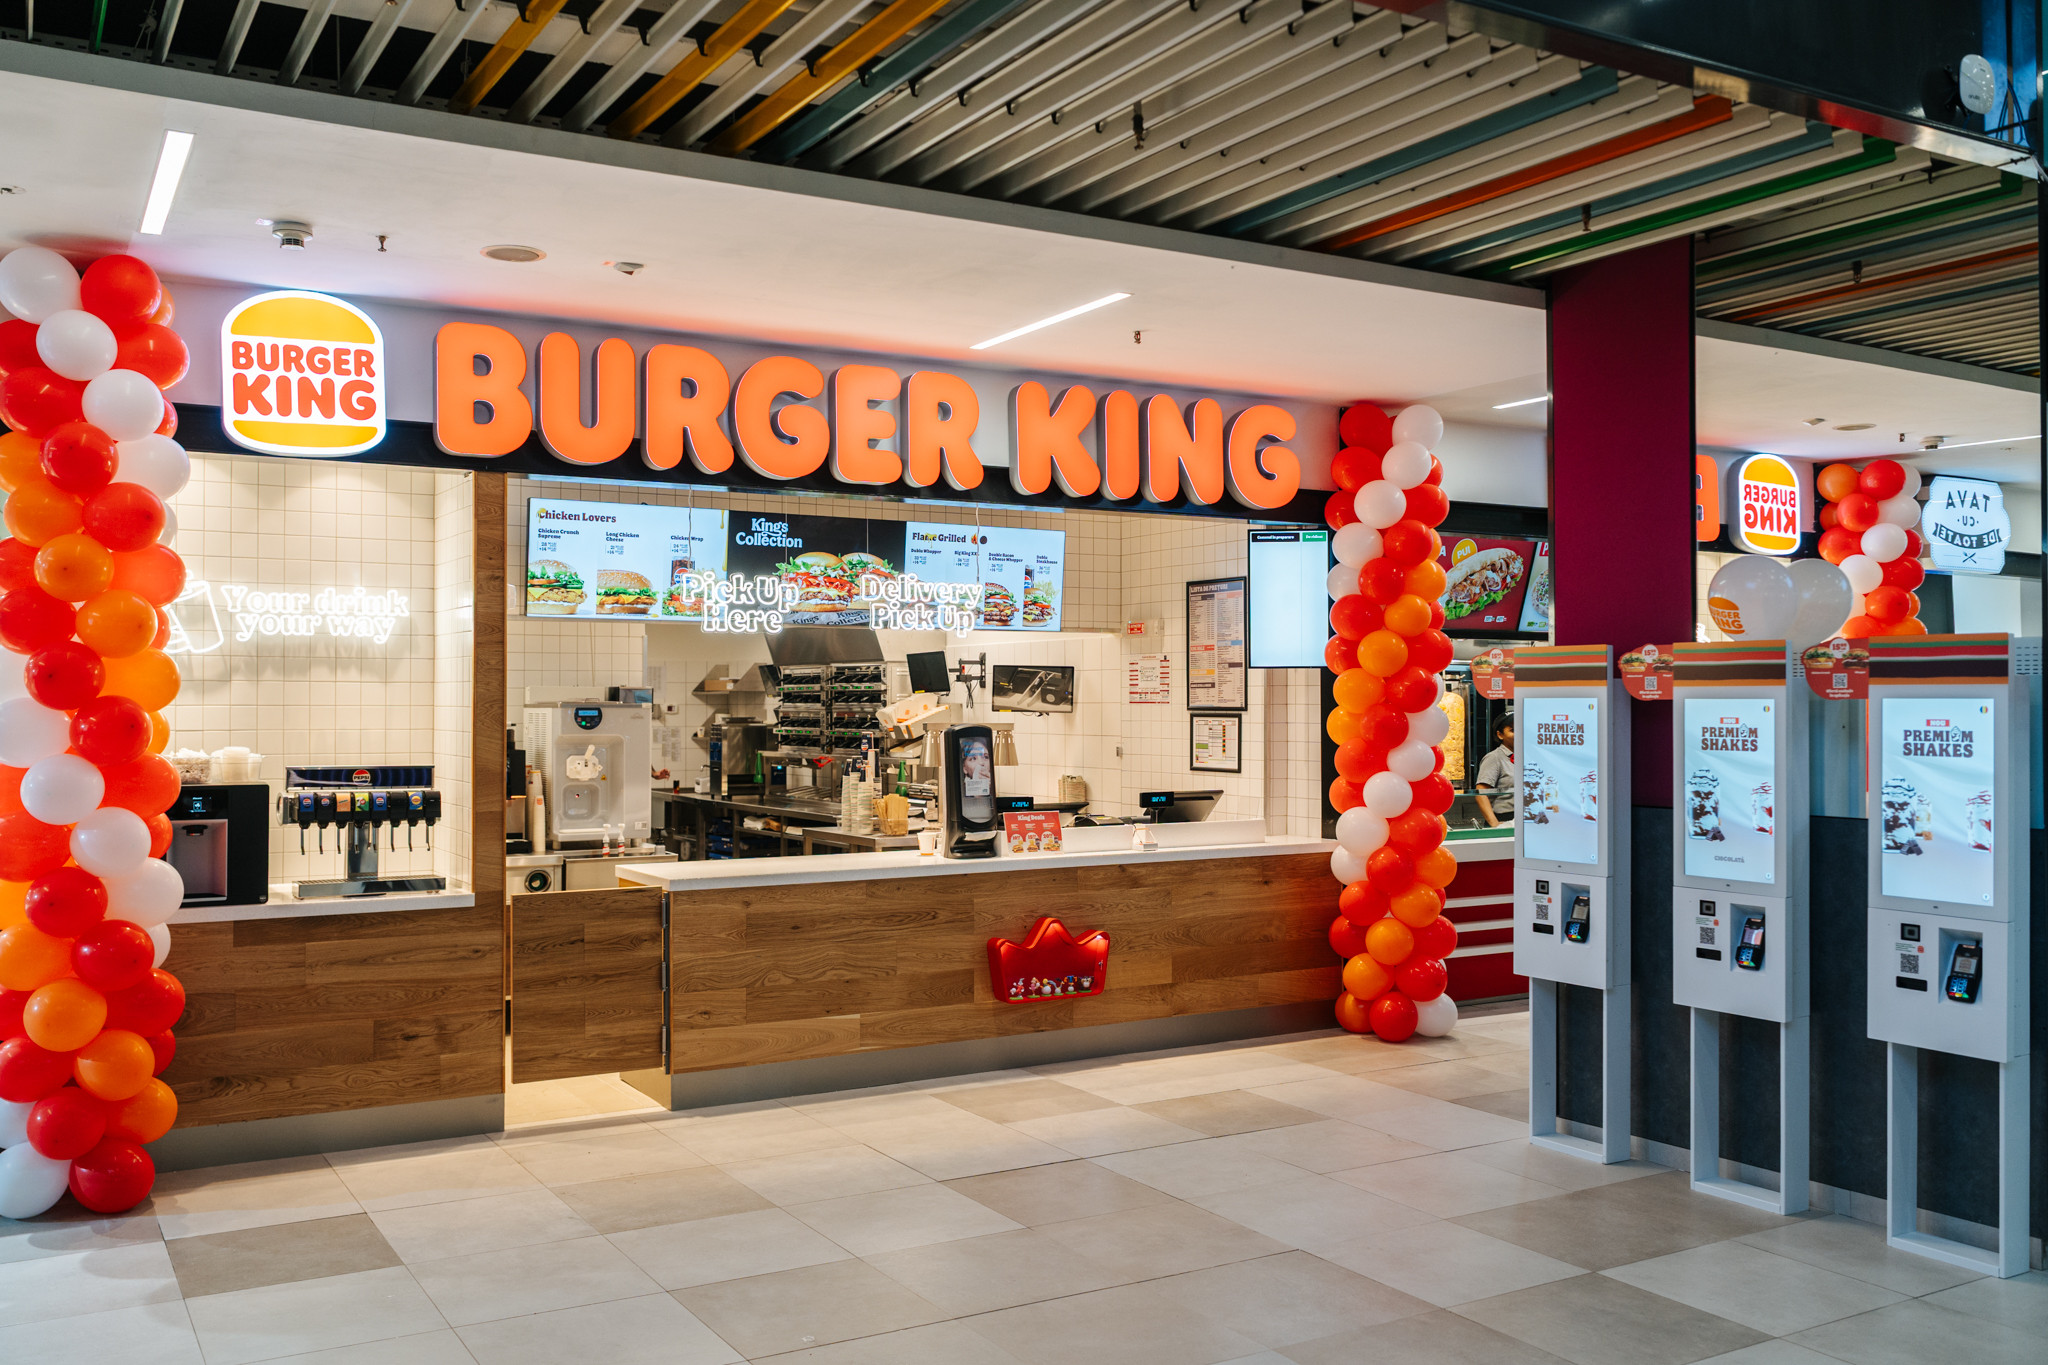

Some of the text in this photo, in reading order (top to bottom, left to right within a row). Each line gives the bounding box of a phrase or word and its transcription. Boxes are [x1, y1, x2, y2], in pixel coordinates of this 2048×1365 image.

[232, 341, 376, 378] BURGER
[232, 372, 377, 421] KING
[433, 321, 1302, 510] BURGER KING
[538, 510, 617, 523] Chicken Lovers
[736, 532, 803, 549] Collection
[938, 533, 966, 543] Grilled
[1457, 546, 1470, 559] PUI
[221, 585, 409, 618] Your drink
[681, 571, 799, 613] Pick Up
[860, 573, 983, 609] Delivery
[236, 612, 395, 644] your way
[702, 602, 783, 633] Here
[870, 601, 975, 638] Pick Up
[1713, 617, 1743, 629] ING
[1537, 733, 1584, 746] SHAKES
[1701, 738, 1758, 752] SHAKES
[1903, 742, 1973, 758] SHAKES
